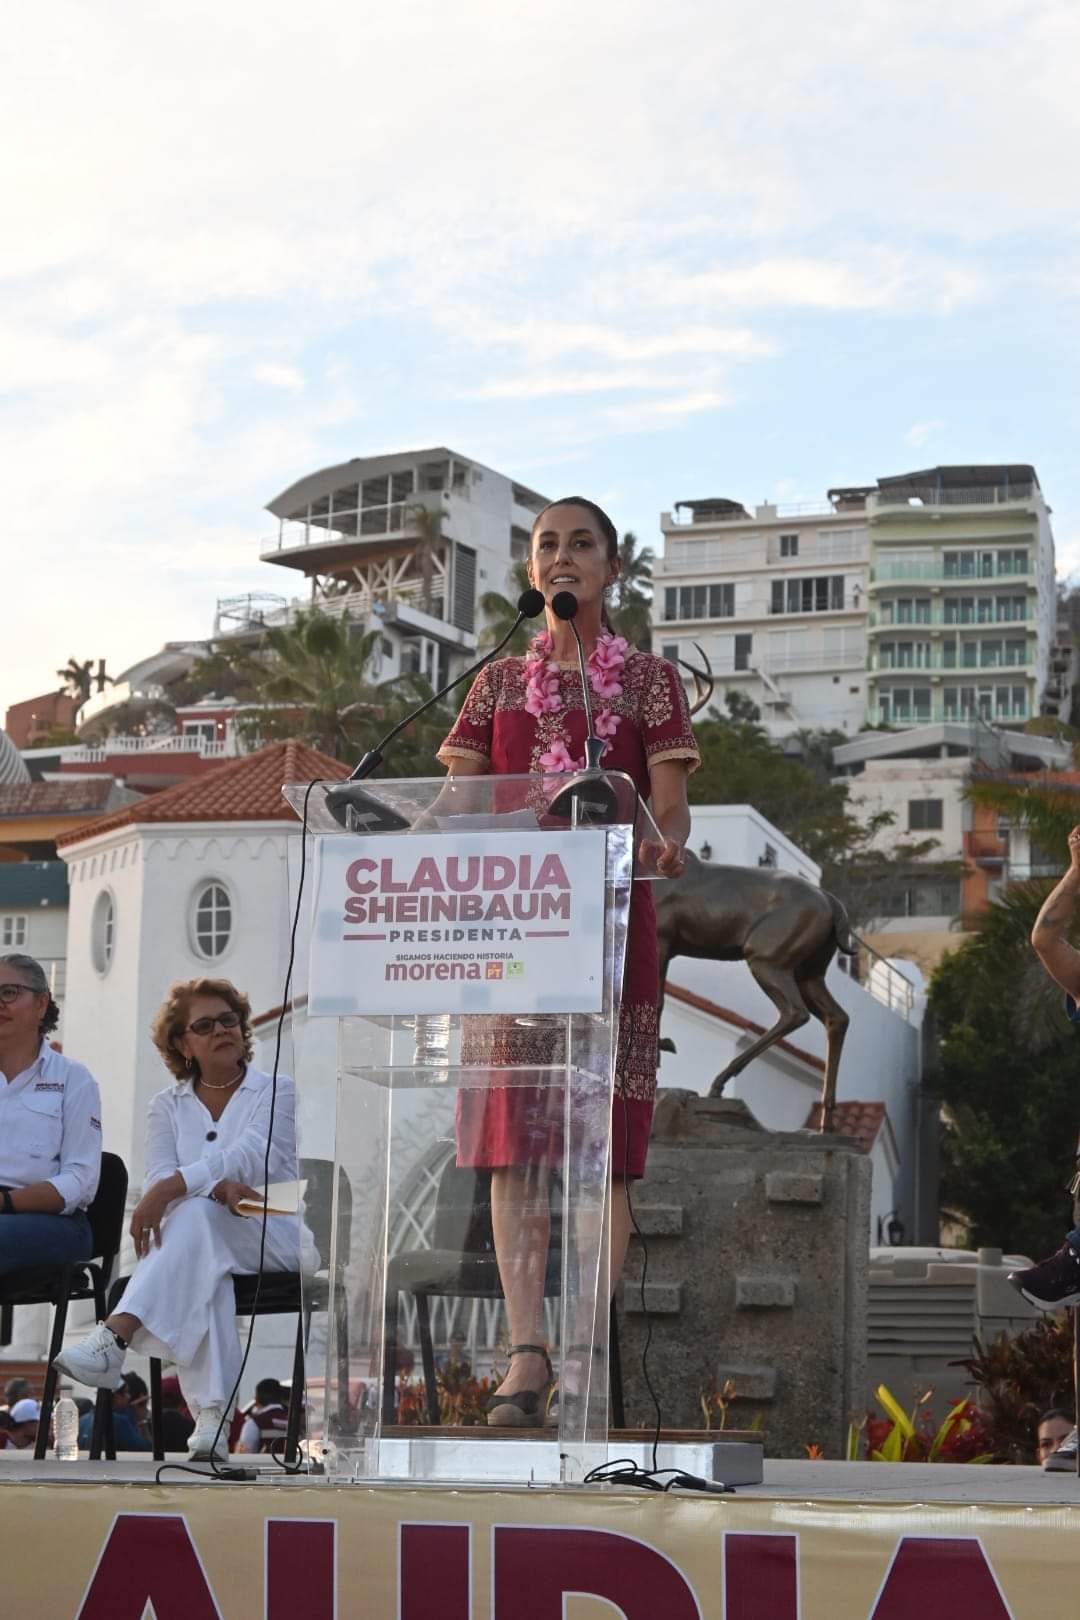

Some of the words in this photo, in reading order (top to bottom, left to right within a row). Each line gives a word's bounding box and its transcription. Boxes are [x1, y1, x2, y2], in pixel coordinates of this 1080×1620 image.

[345, 854, 571, 894] CLAUDIA
[343, 892, 571, 924] SHEINBAUM
[389, 928, 522, 942] PRESIDENTA
[395, 953, 431, 961] SIGAMOS
[433, 952, 474, 960] HACIENDO
[477, 952, 514, 960] HISTORIA
[384, 961, 481, 980] morena
[487, 967, 502, 979] PT
